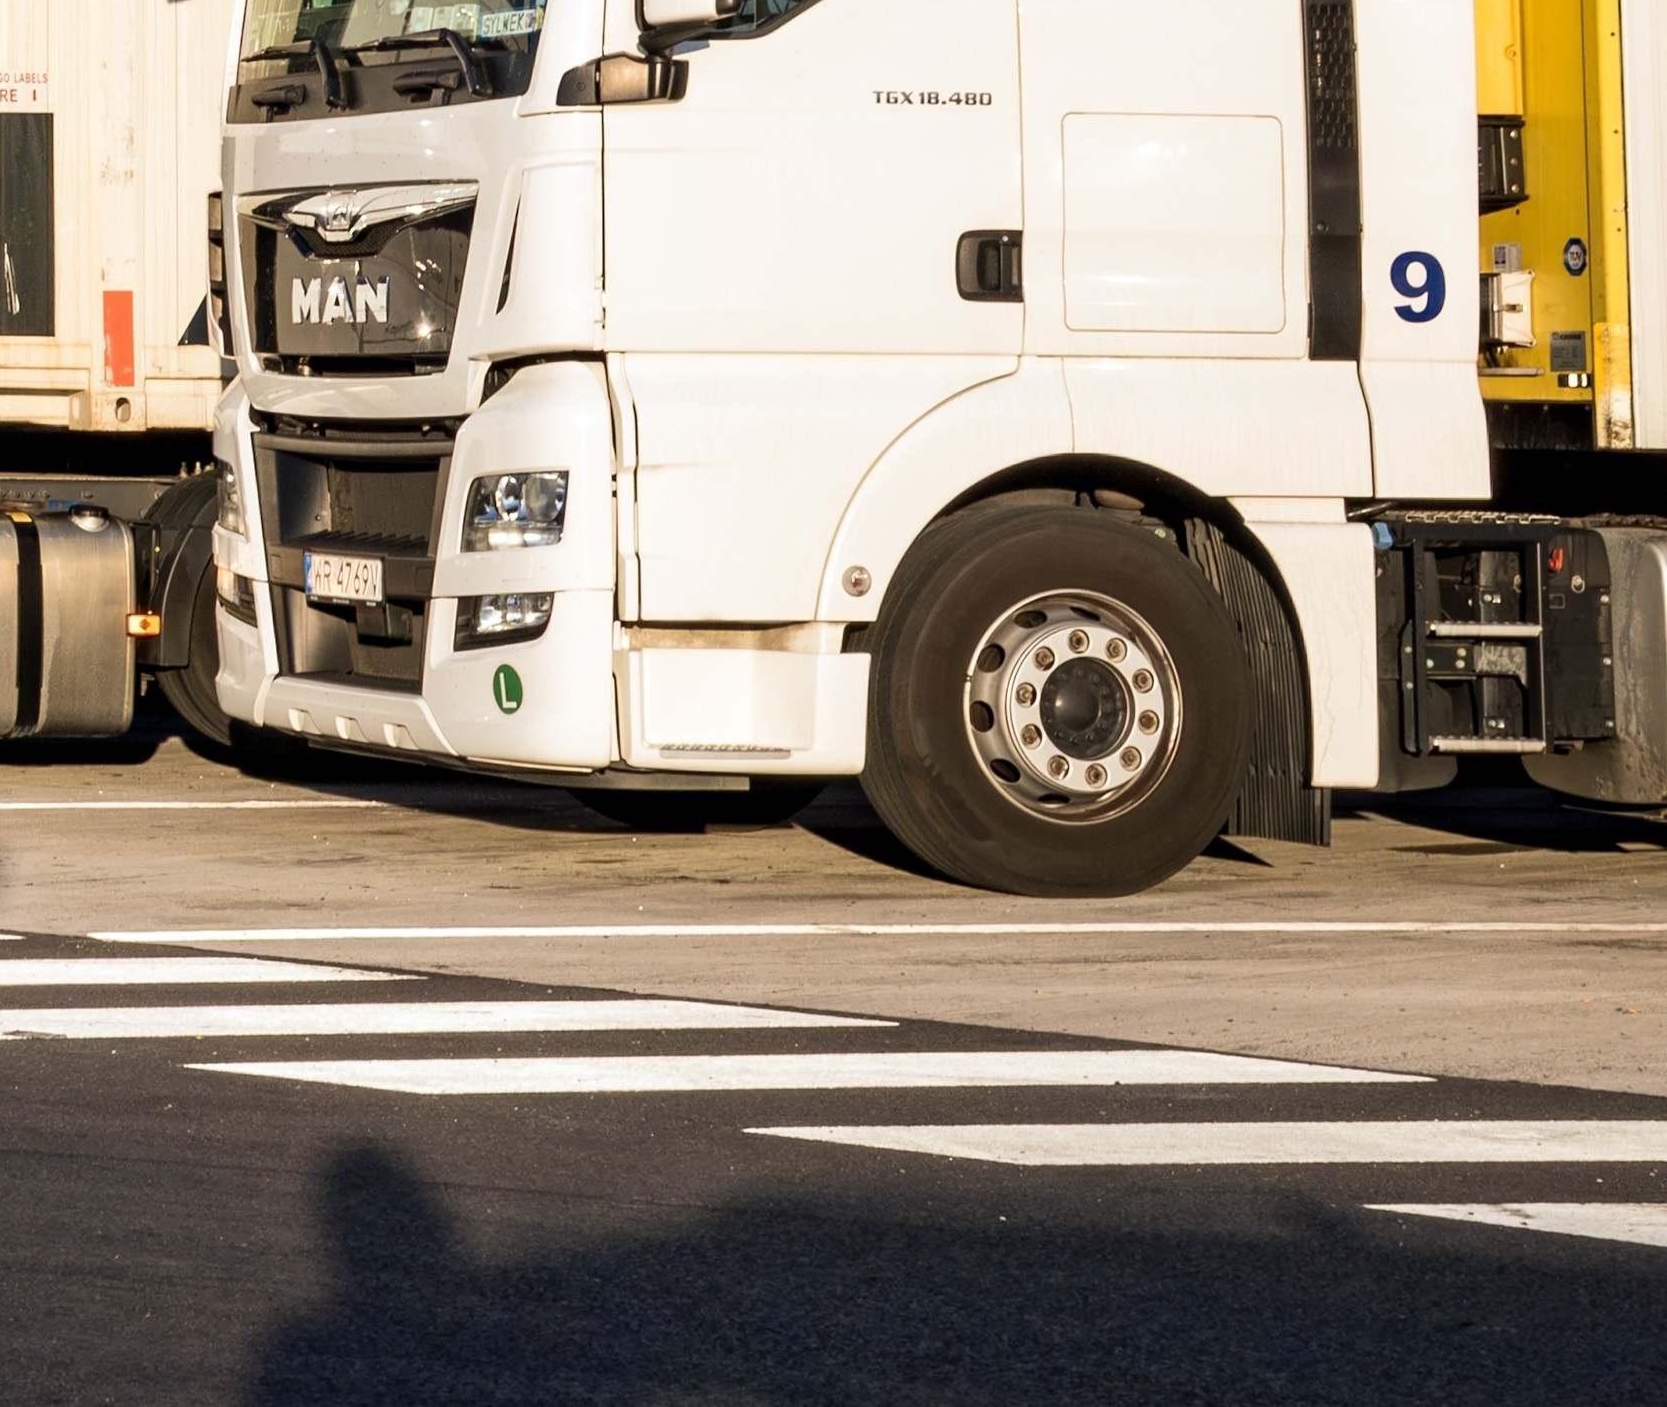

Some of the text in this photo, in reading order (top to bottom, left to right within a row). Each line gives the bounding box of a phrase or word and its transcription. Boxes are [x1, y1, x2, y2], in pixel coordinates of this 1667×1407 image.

[483, 13, 525, 35] SYLWEK
[14, 72, 48, 84] LABELS
[291, 275, 390, 325] MAN
[1389, 250, 1446, 323] 9
[499, 672, 517, 709] L
